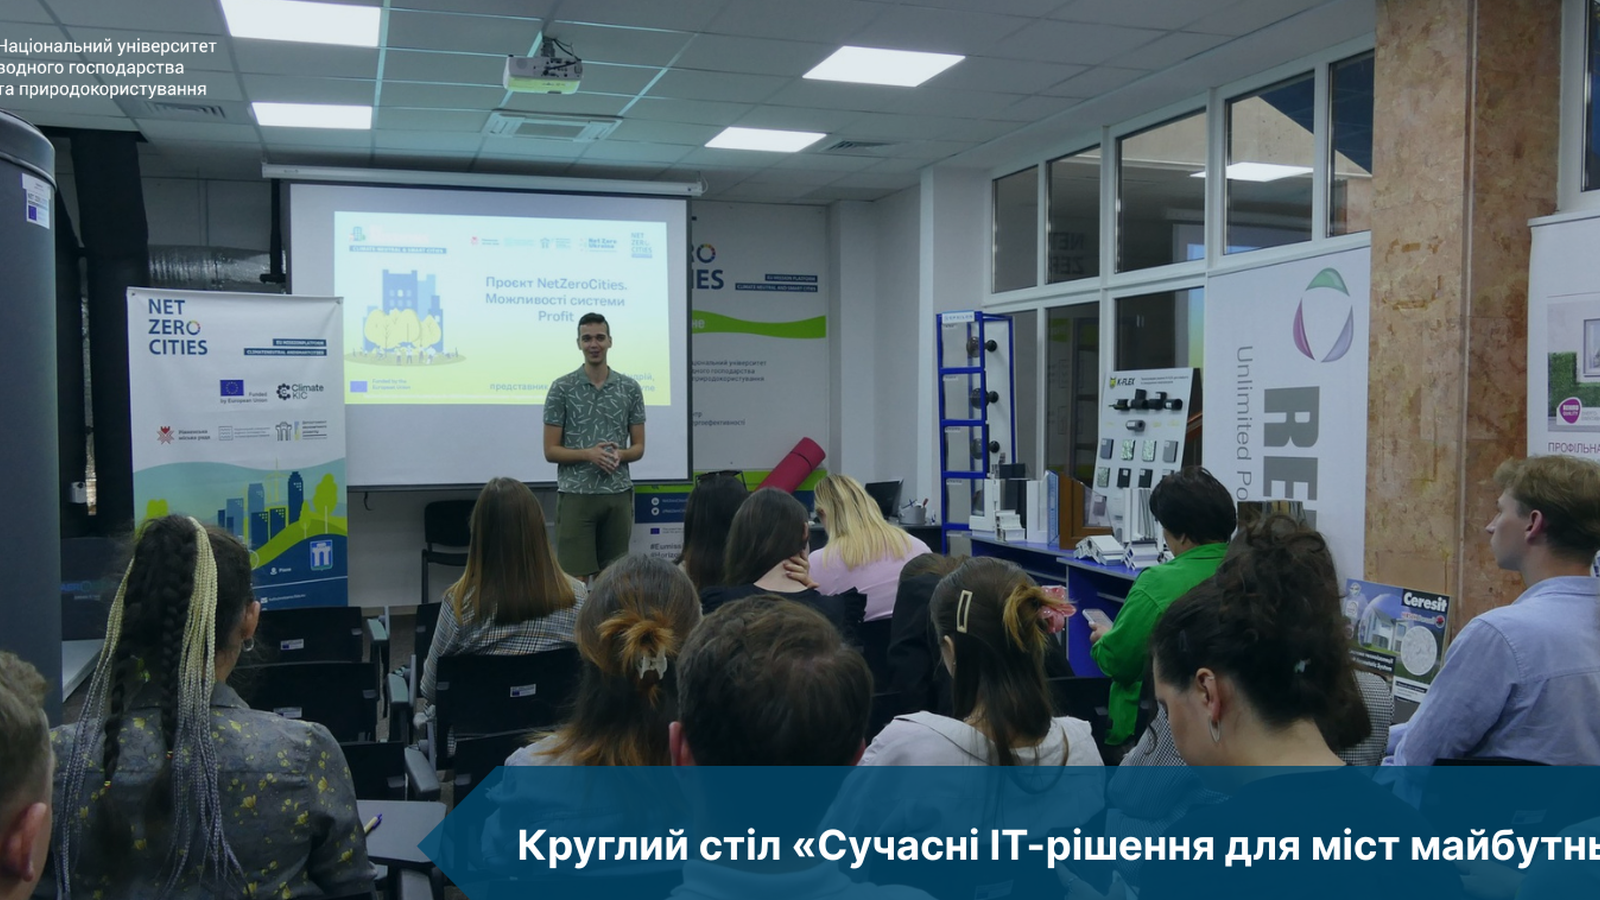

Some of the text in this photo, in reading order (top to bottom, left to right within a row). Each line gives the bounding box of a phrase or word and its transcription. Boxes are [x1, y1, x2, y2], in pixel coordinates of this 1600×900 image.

[486, 276, 628, 290] Проєкт NetZeroCities.
[485, 293, 625, 306] Можливості системи
[148, 299, 185, 315] NET
[538, 310, 574, 322] Profit
[148, 319, 201, 335] ZERO
[149, 339, 208, 355] CITIES
[291, 384, 325, 392] Climate
[490, 383, 549, 392] представник
[1117, 378, 1136, 386] K-FLEX
[292, 392, 308, 400] KIC
[1237, 346, 1253, 460] Unlimited
[1403, 592, 1447, 612] Ceresit
